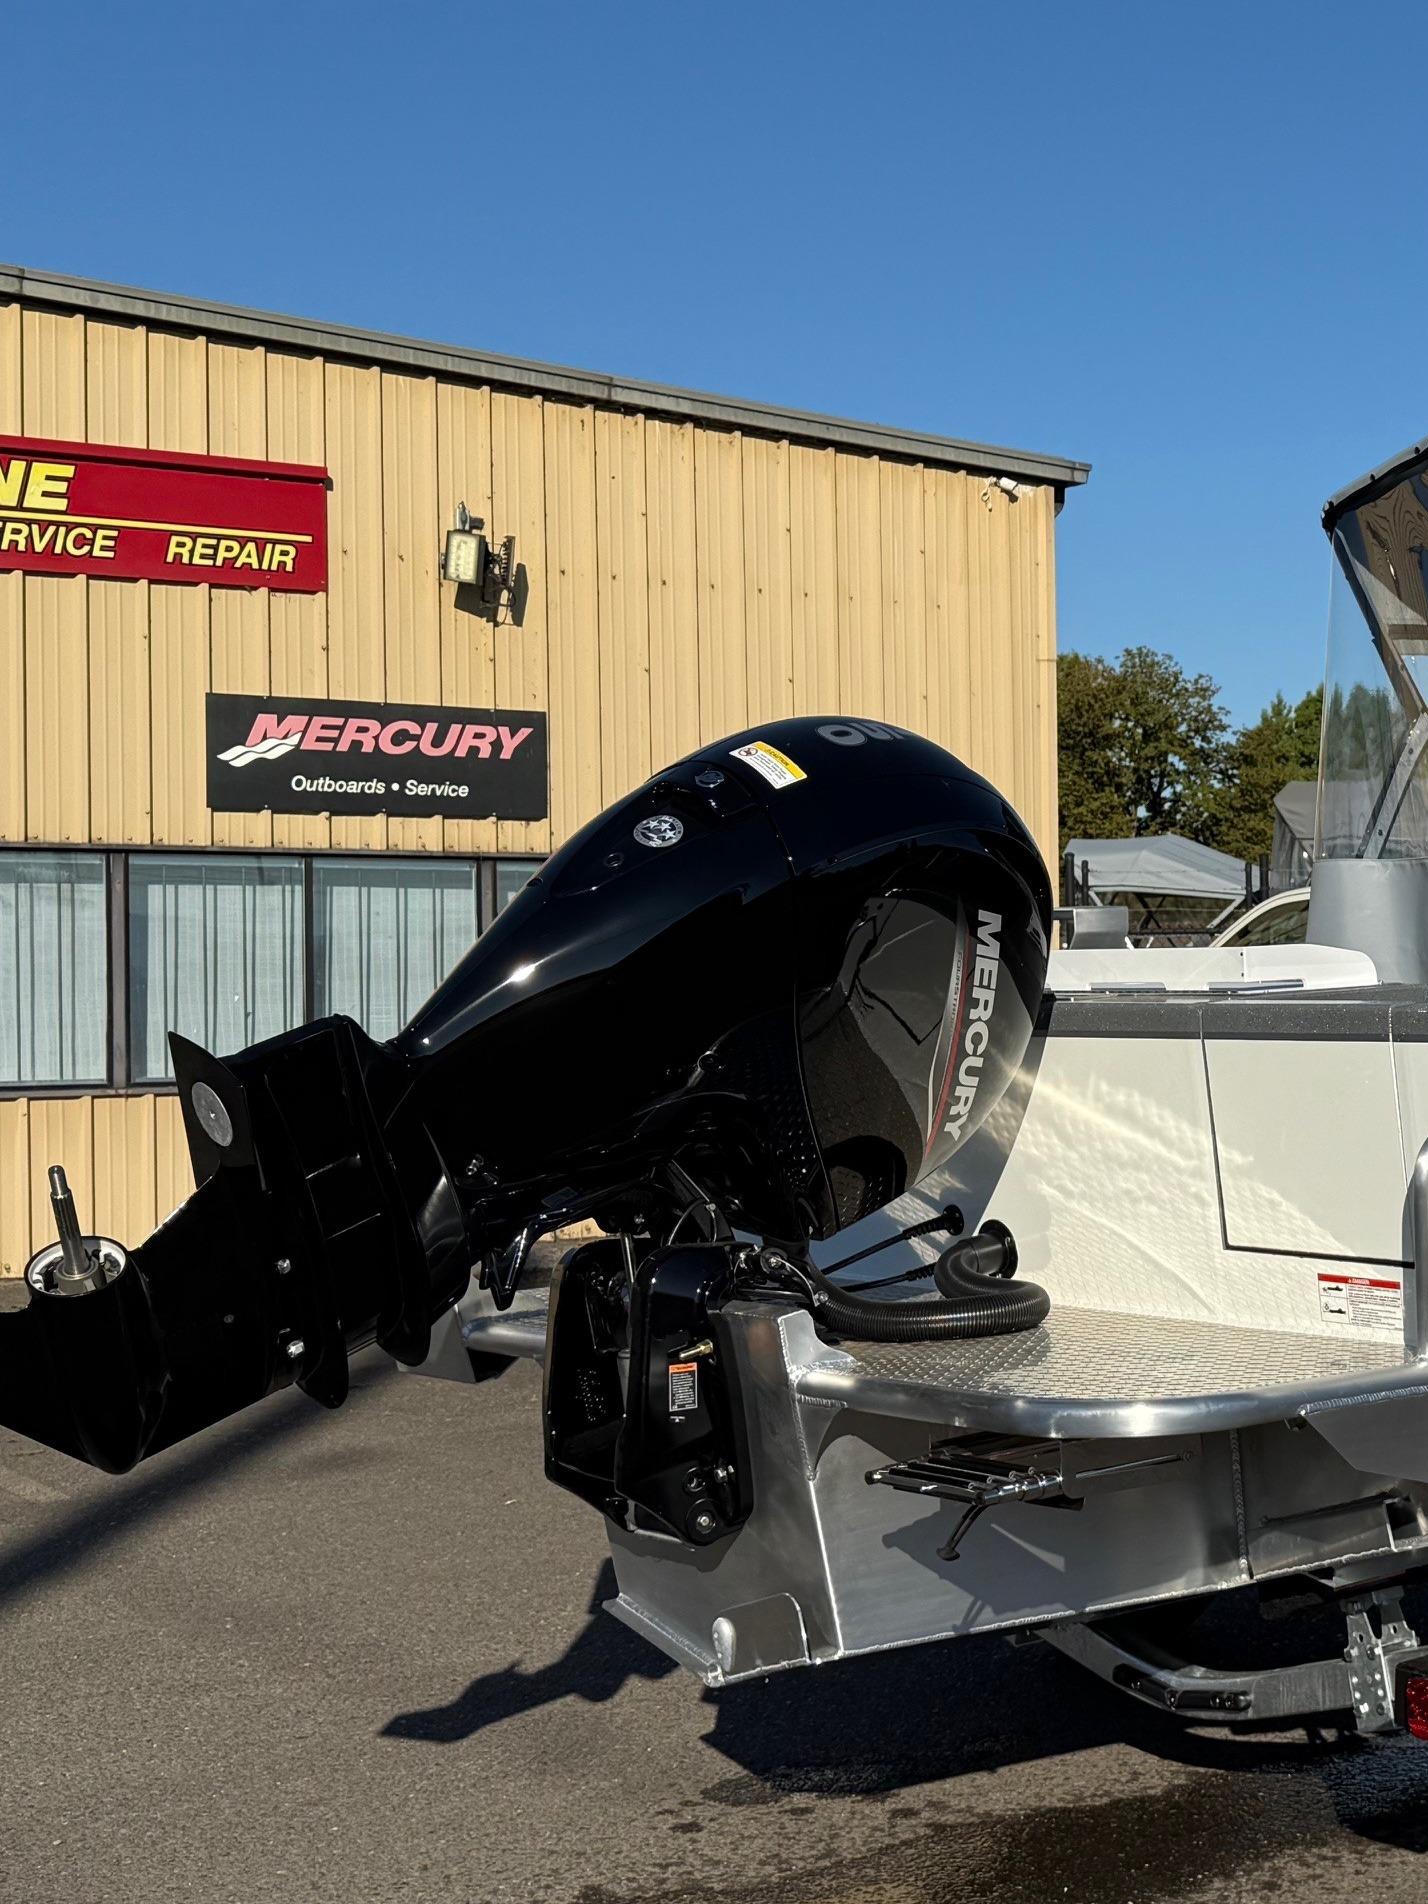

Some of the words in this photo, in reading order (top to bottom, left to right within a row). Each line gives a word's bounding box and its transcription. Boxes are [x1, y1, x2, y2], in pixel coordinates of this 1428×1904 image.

[0, 521, 119, 559] RVICE
[165, 535, 297, 573] REPAIR
[244, 713, 534, 760] MERCURY
[291, 775, 386, 795] Outboards
[404, 780, 469, 798] Service
[944, 909, 1002, 1141] MERCURY
